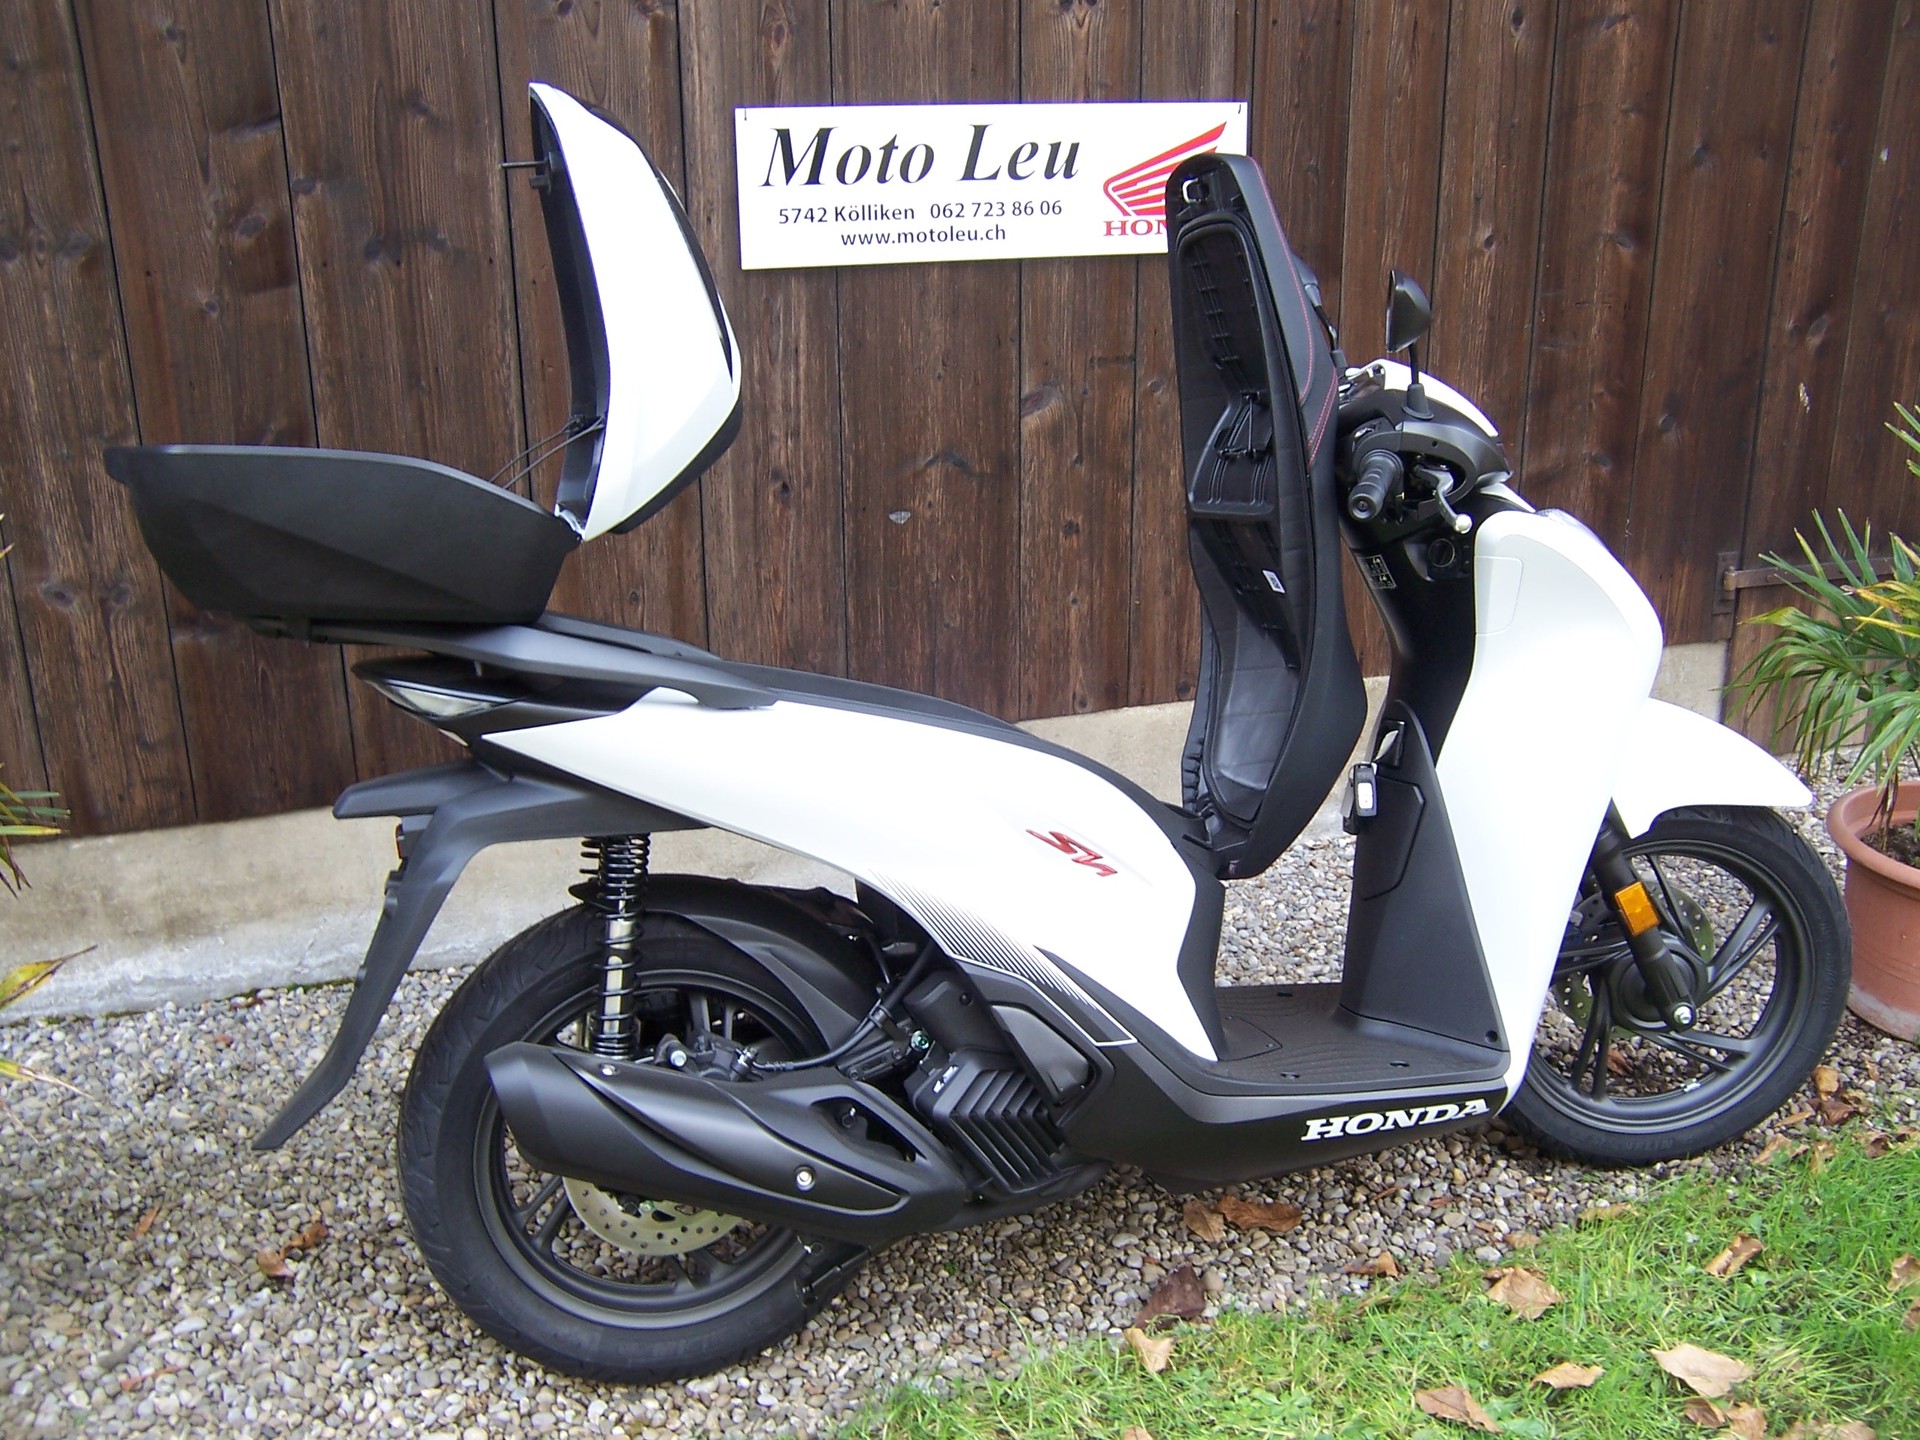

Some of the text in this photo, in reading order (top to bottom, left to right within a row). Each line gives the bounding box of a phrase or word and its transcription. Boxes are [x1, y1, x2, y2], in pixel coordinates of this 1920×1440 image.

[761, 124, 1080, 188] Moto Leu
[778, 200, 1063, 225] 5742 Kölliken 062 723 86 06
[840, 224, 1007, 246] www.motoleu.ch
[1103, 219, 1167, 236] HON
[1300, 1098, 1490, 1141] HONDA
